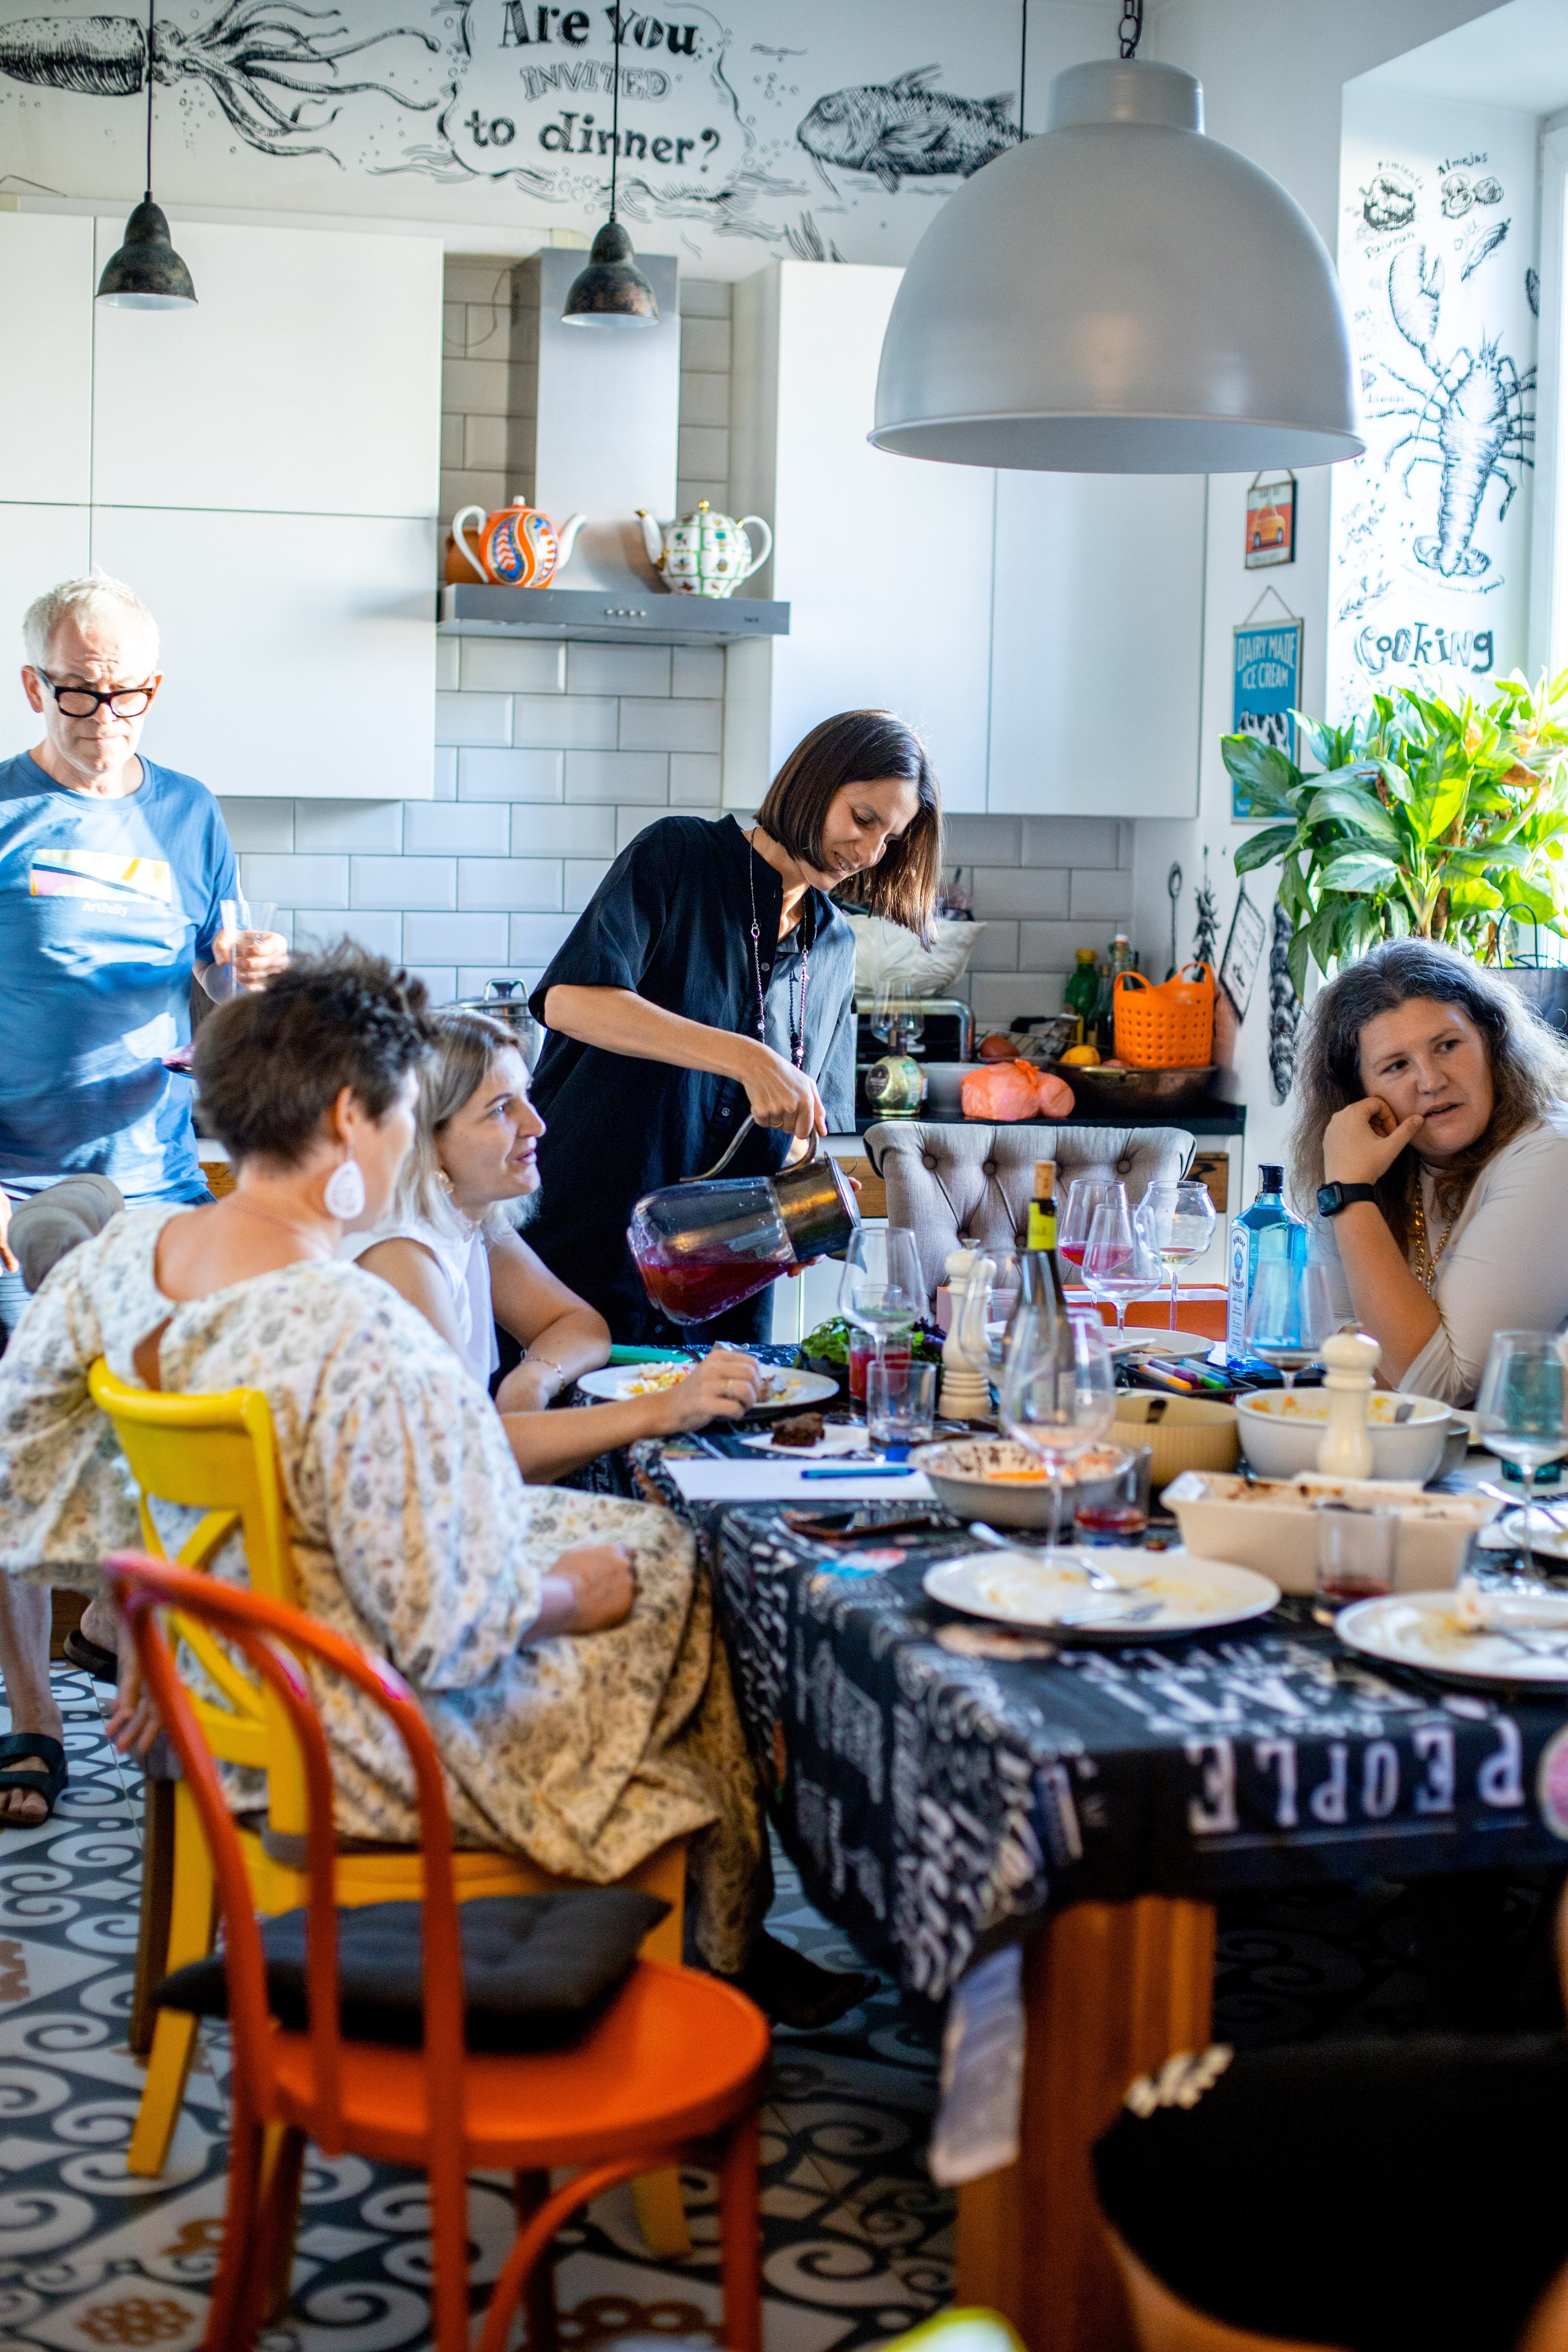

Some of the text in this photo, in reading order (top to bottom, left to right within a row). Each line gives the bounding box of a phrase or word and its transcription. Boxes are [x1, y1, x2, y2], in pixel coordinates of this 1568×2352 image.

[497, 0, 699, 56] Are You
[519, 59, 671, 102] INVITED
[464, 109, 721, 173] to dinner?
[1237, 633, 1296, 671] DAIRY MADE
[1242, 662, 1289, 689] ICE CREAM
[81, 902, 129, 916] Artfully
[1184, 1709, 1525, 1834] PEOPLE
